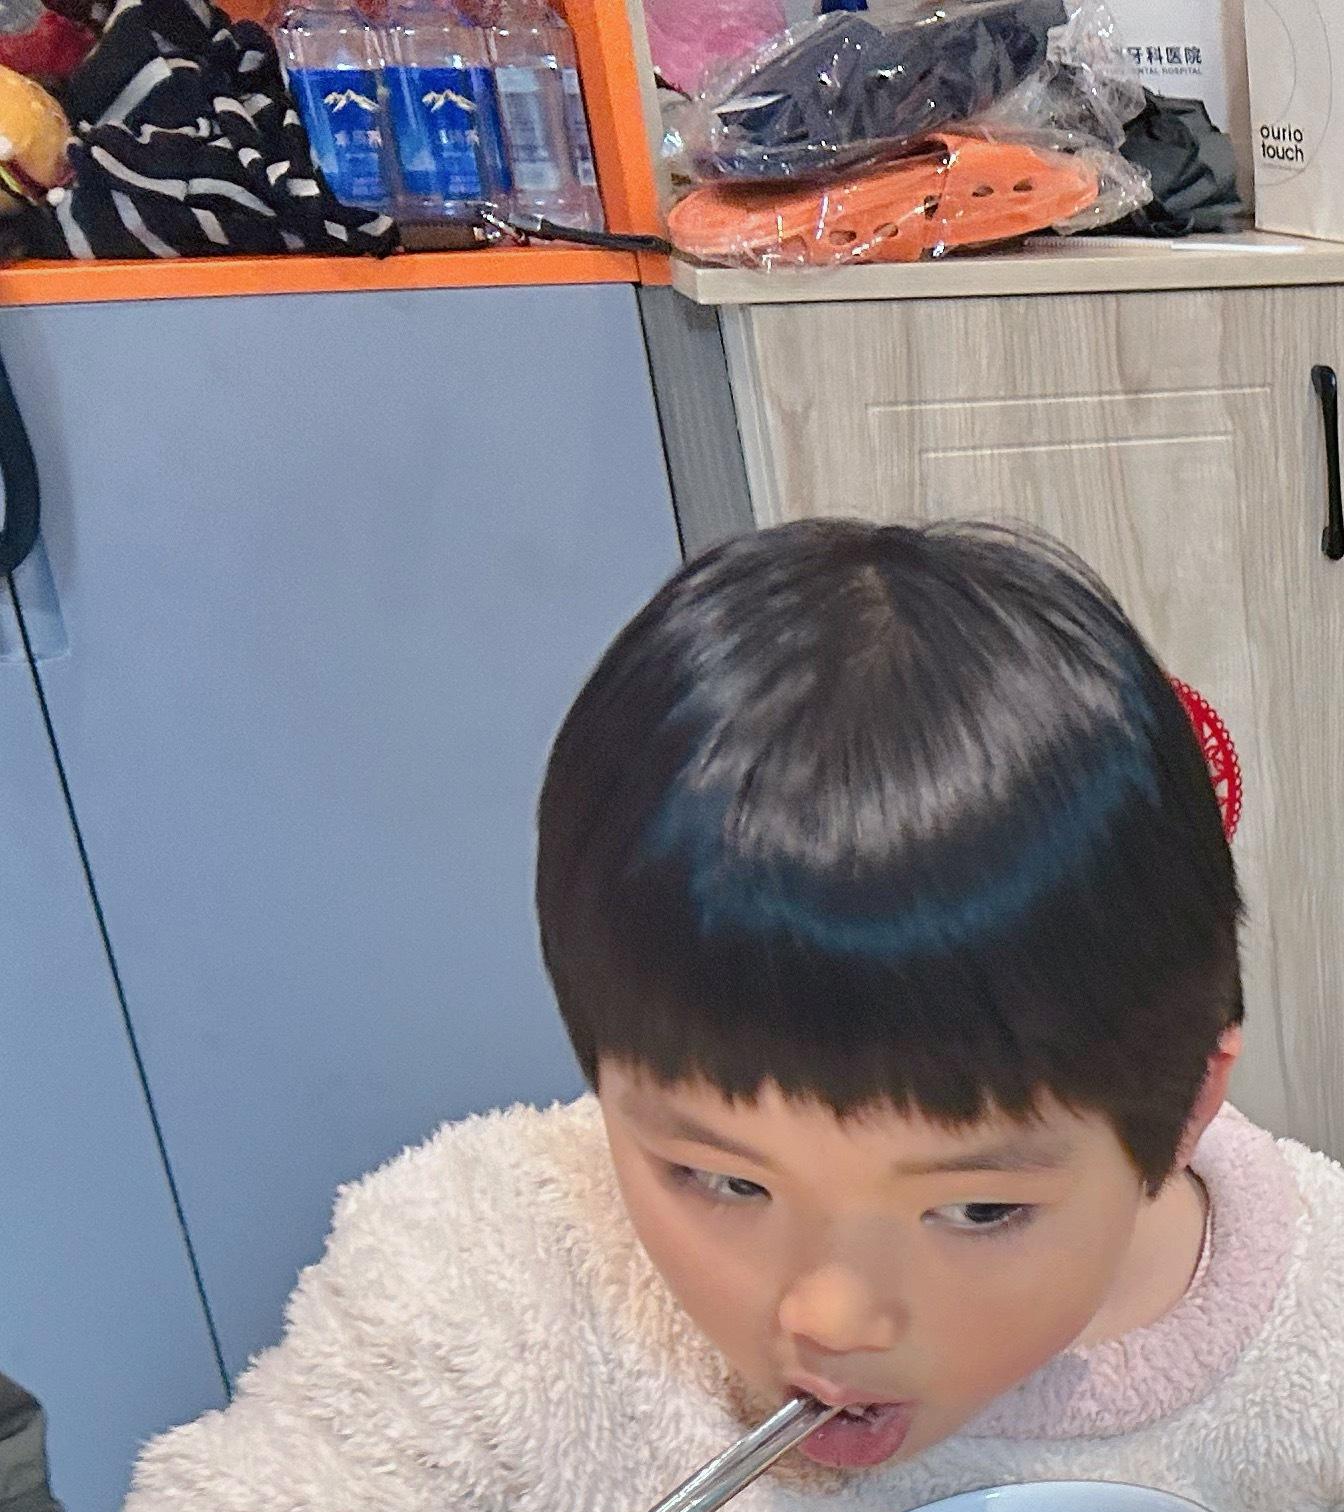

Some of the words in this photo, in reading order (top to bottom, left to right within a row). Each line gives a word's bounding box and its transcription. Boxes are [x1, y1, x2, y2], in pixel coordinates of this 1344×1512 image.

[1119, 46, 1202, 65] 牙科医院
[1261, 140, 1305, 162] touch
